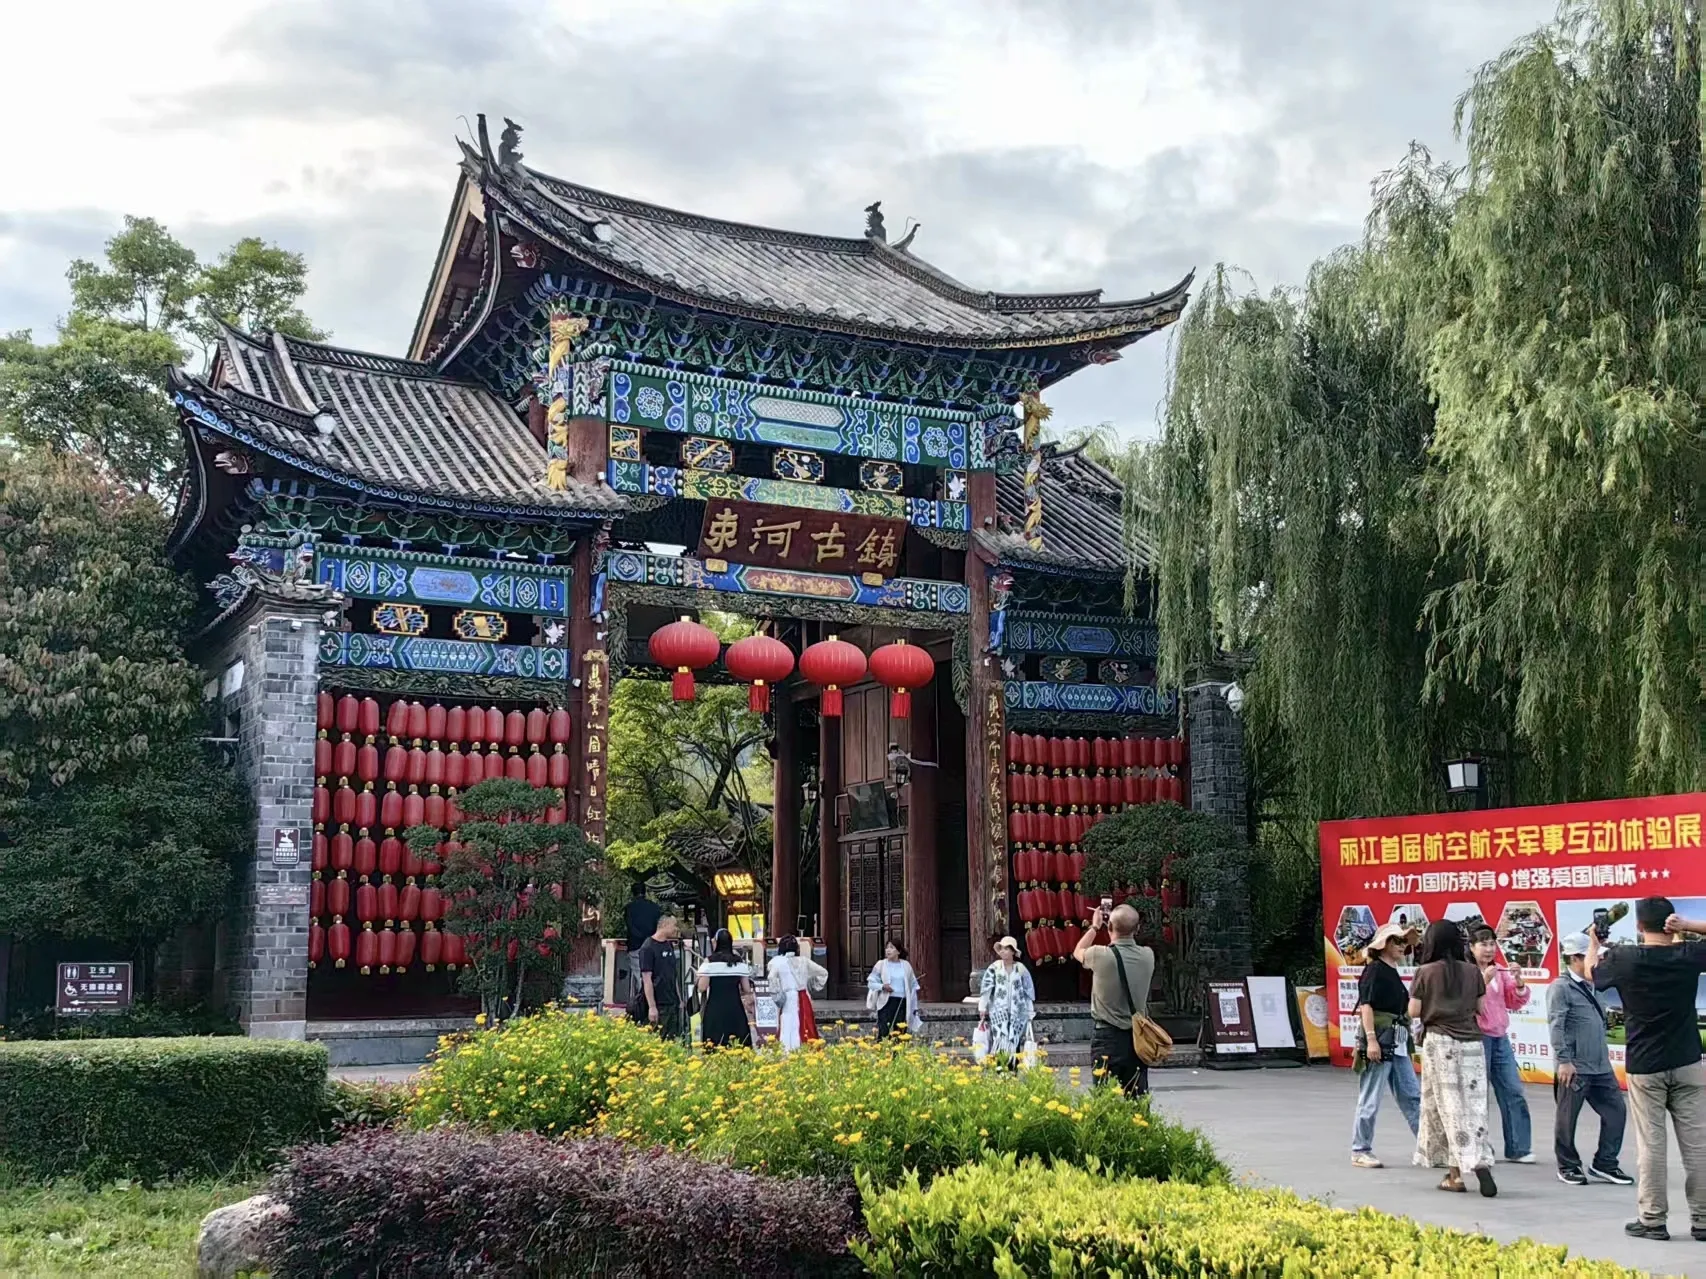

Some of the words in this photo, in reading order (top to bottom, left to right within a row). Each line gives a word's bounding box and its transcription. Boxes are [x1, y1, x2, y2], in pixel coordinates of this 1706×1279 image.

[1339, 813, 1702, 867] 丽江首届航空航天军事互动体验展
[88, 966, 116, 974] 卫生间
